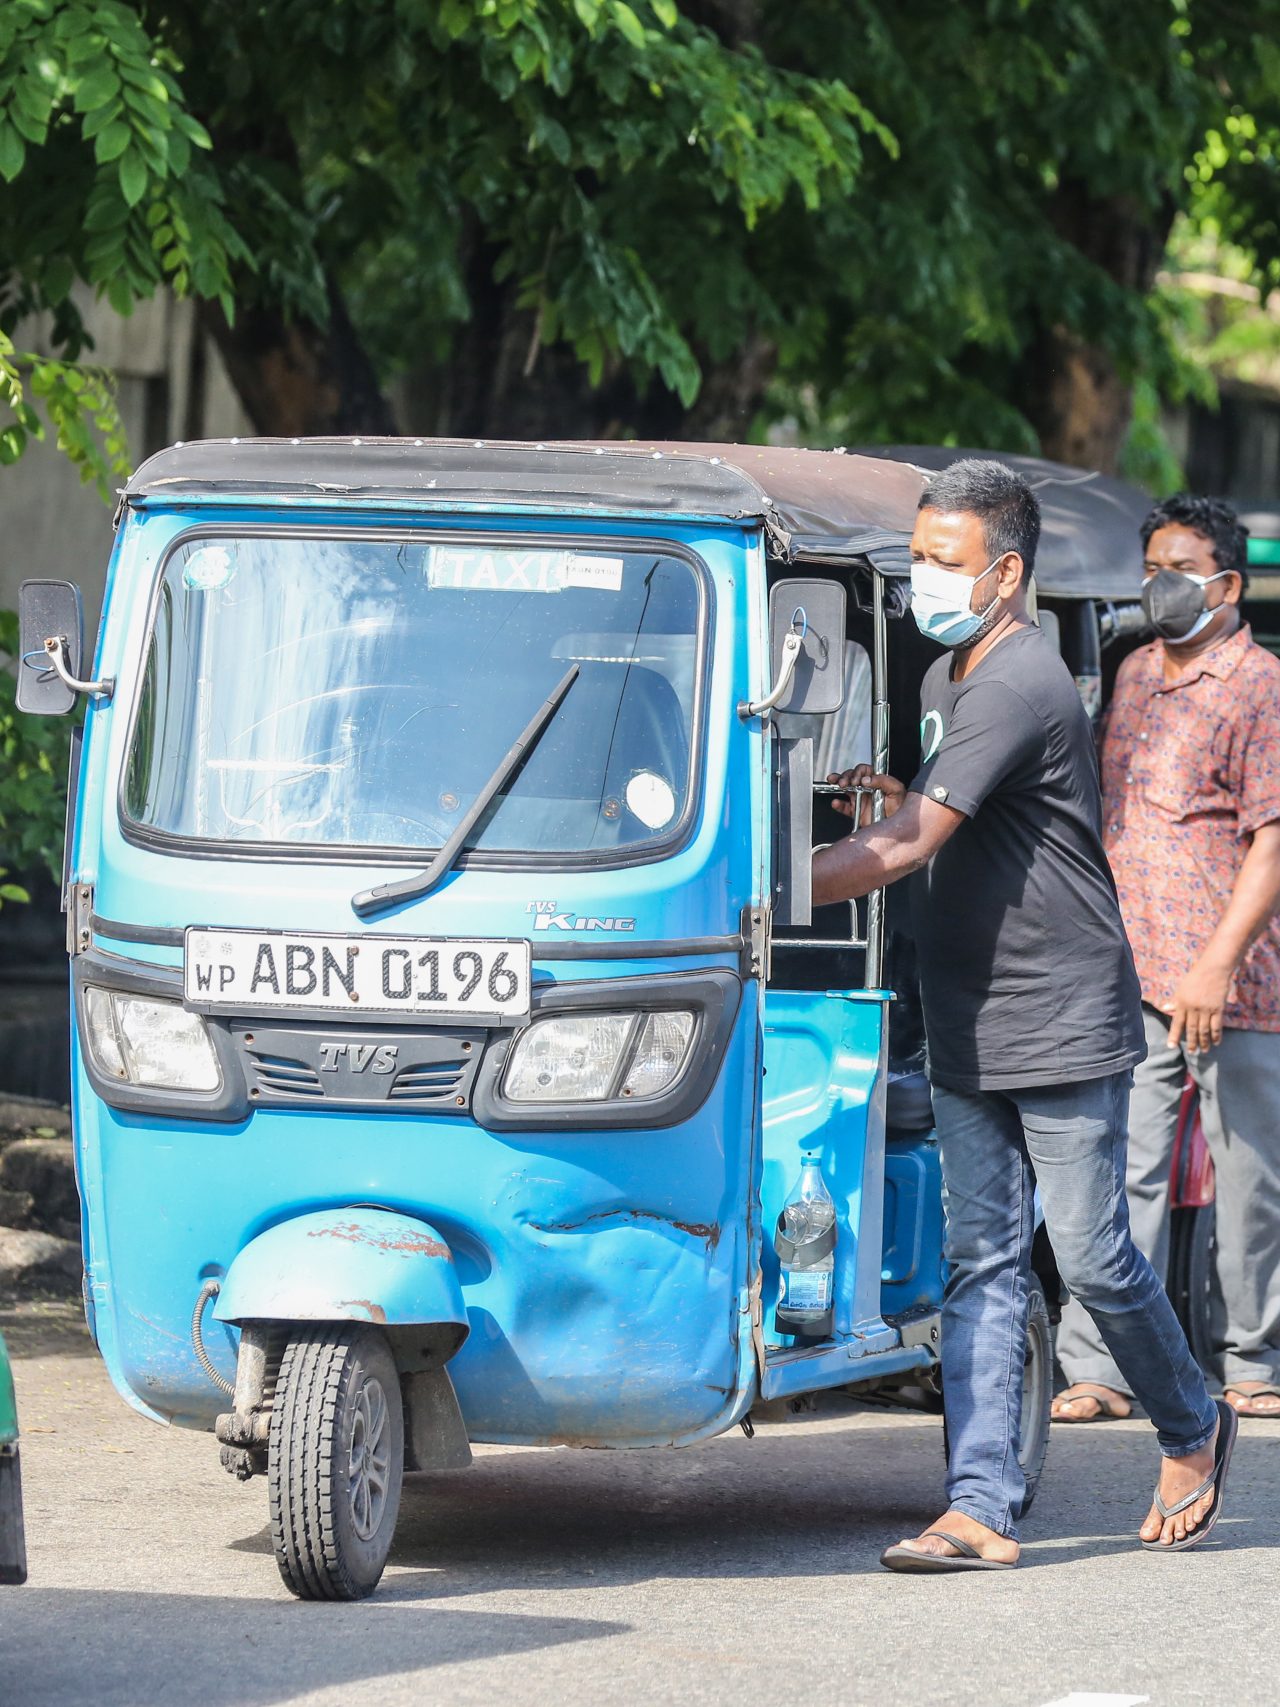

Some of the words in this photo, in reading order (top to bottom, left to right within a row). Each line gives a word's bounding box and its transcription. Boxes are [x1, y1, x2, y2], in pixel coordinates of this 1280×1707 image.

[447, 553, 553, 589] TAXI
[534, 913, 636, 931] KING
[196, 964, 235, 992] WP
[250, 943, 355, 997] ABN
[381, 949, 519, 1002] 0196
[320, 1043, 398, 1074] TVS
